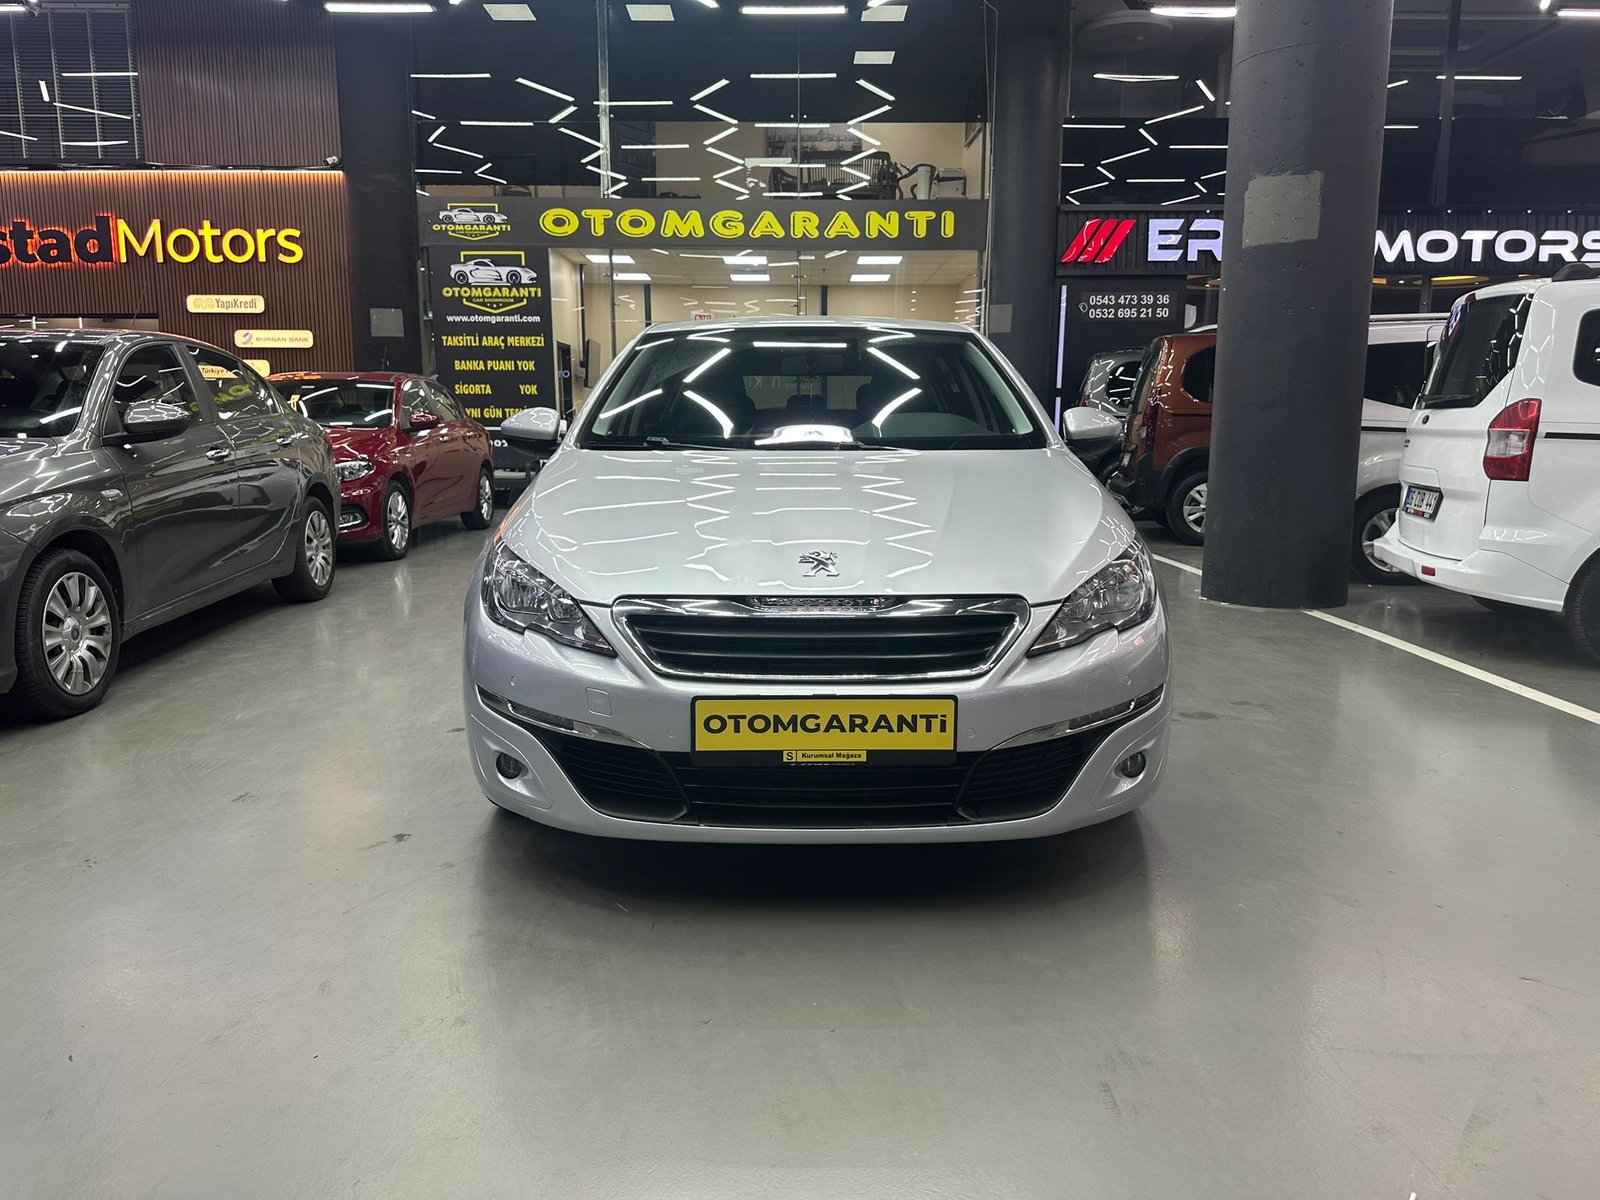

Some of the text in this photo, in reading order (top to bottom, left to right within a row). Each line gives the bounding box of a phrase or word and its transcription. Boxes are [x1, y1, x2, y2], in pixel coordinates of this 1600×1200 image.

[539, 208, 956, 238] OTOMGARANTI
[442, 287, 542, 297] OTOMGARANTI
[215, 298, 257, 310] YapıKredi
[1089, 294, 1170, 305] 0543 473 39 36
[1088, 308, 1169, 318] 0532 695 21 50
[446, 314, 541, 324] www.otomgaranti.com
[442, 333, 545, 349] TAKSİTLİ ARAÇ MERKEZİ
[454, 360, 536, 371] BANKA PUANI YOK
[454, 381, 538, 395] SİGORTA YOK
[465, 408, 481, 418] YNI
[484, 405, 503, 418] GÜN
[835, 752, 862, 760] Mağaza
